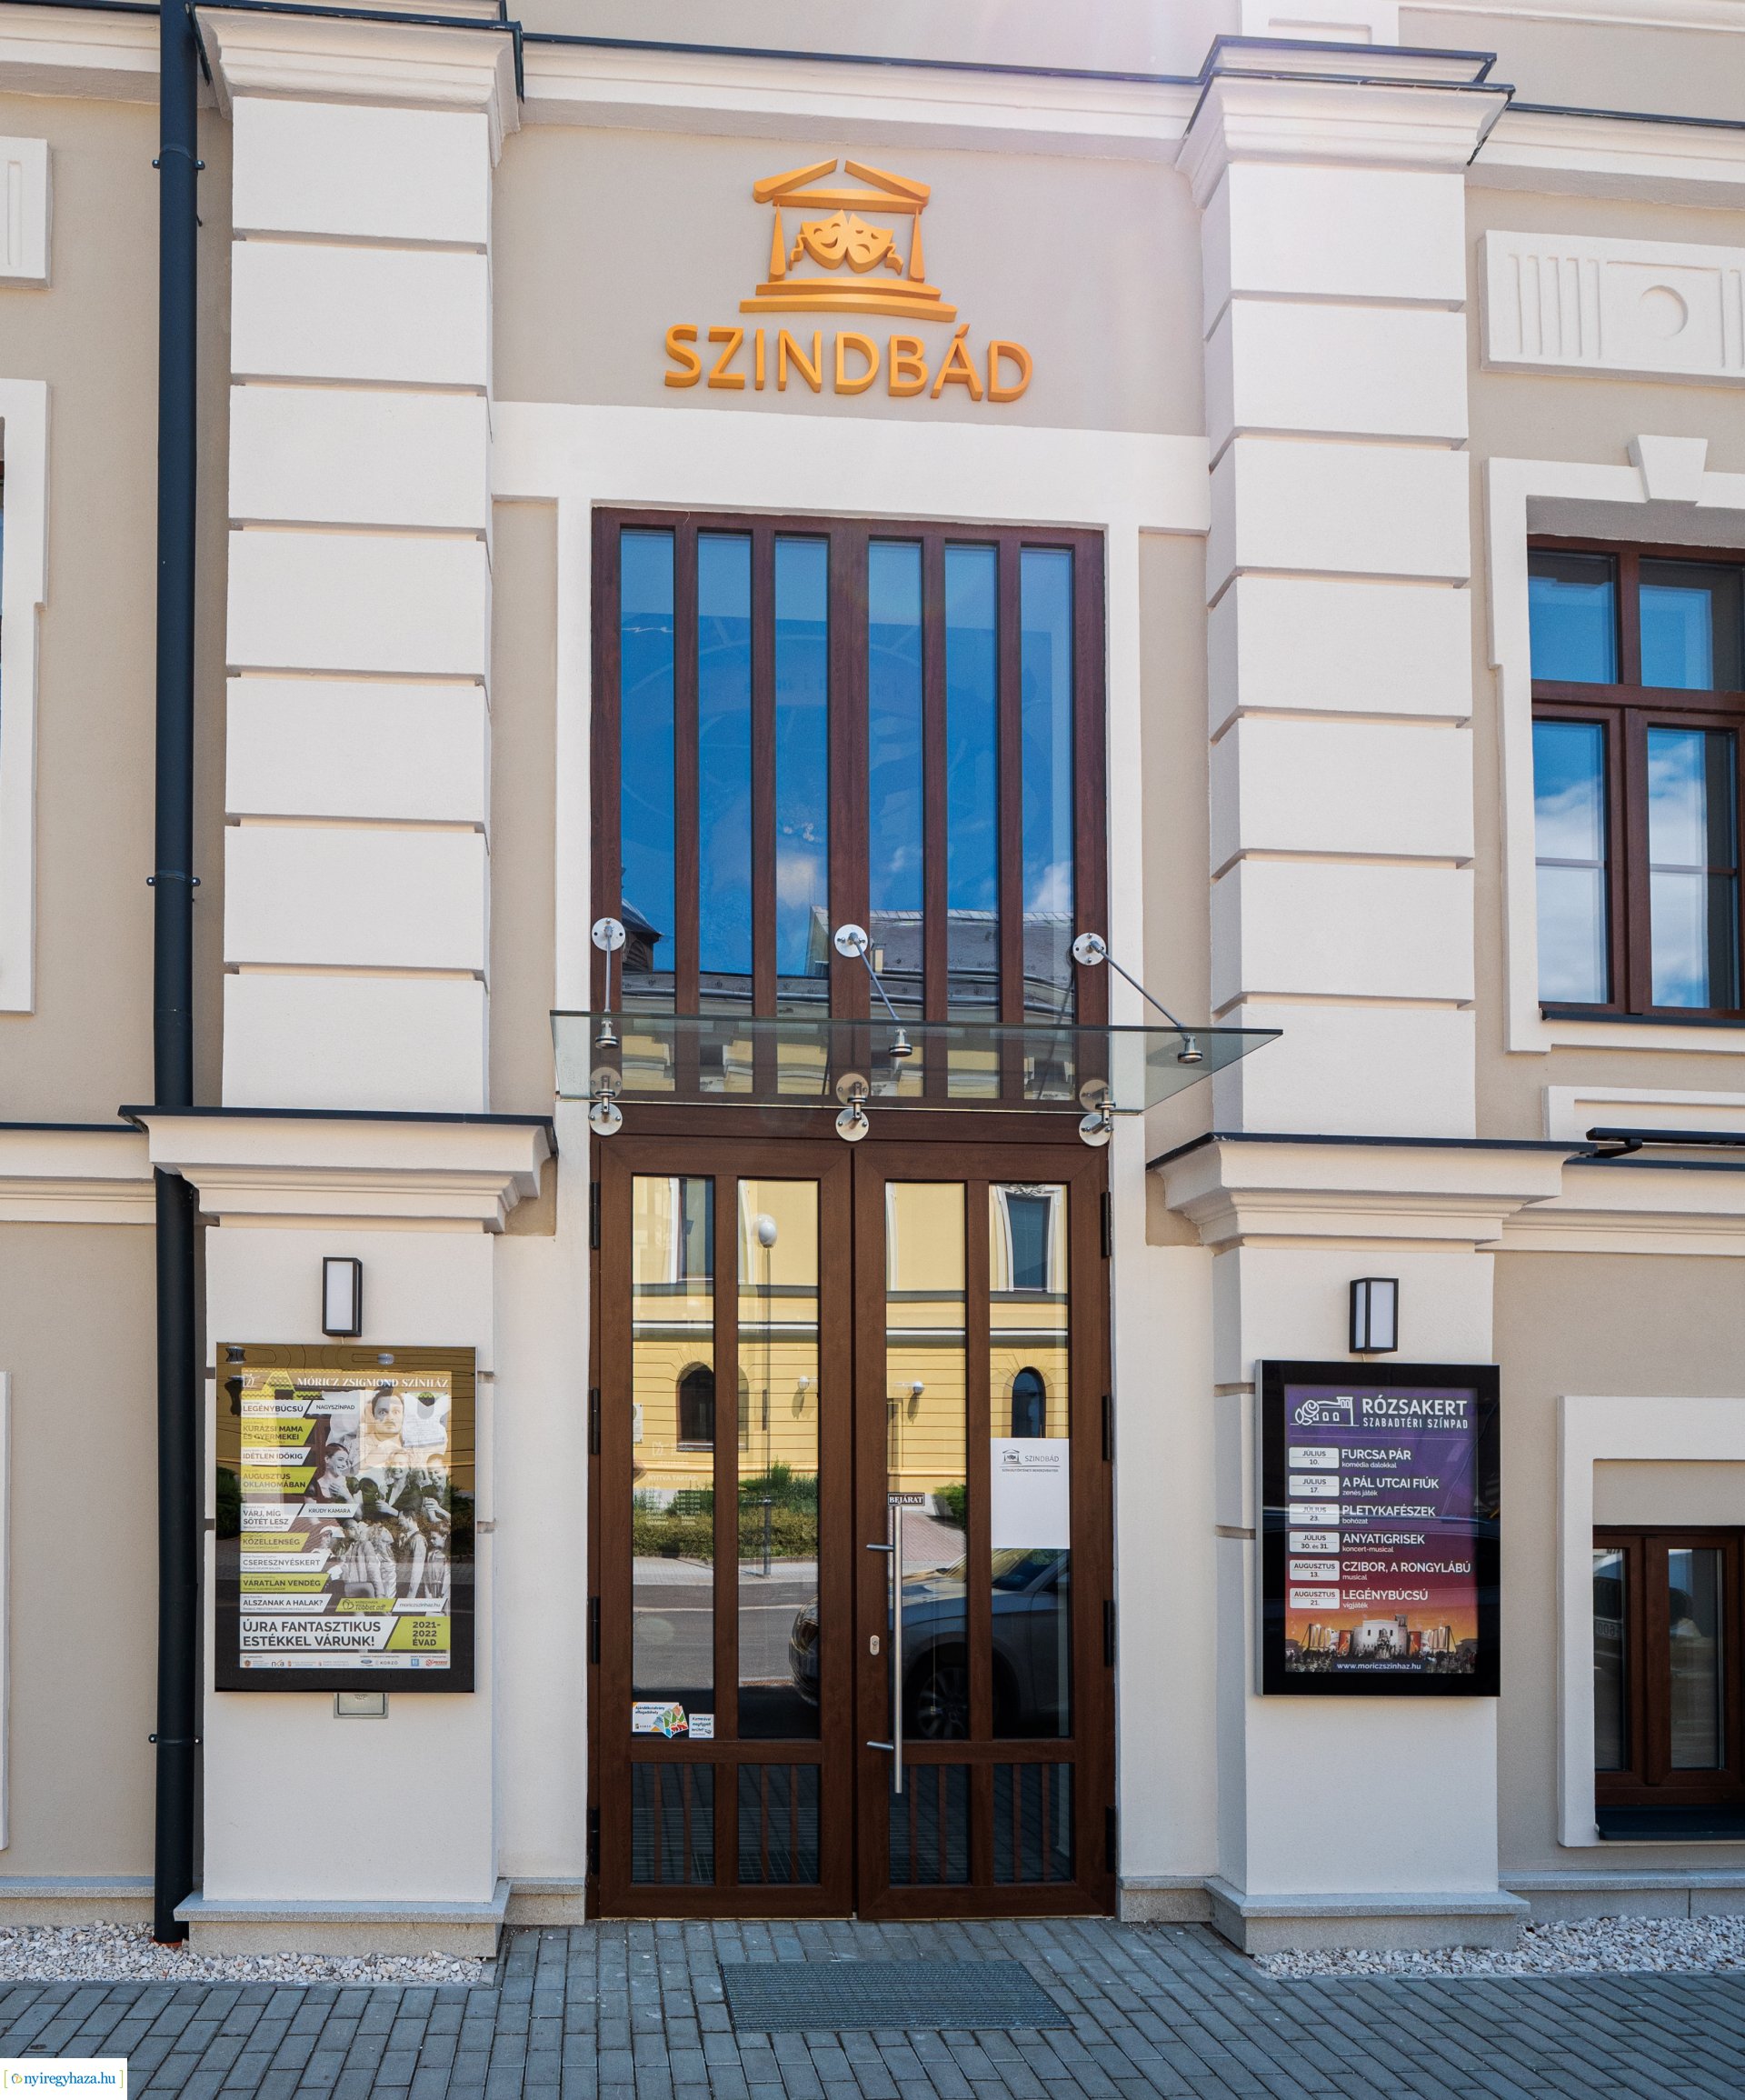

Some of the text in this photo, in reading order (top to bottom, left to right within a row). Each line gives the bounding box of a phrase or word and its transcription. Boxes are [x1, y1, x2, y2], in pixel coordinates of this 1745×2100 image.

[664, 323, 1032, 403] SZINDBÁD
[297, 1376, 449, 1387] MÓRICZ ZSIGMOND SZÍNHÁZ
[243, 1404, 304, 1412] LEGÉNYBÚCSÚ
[1362, 1395, 1468, 1415] RÓZSAKERT
[1363, 1416, 1468, 1429] SZABADTÉRI SZÍNPAD
[1341, 1448, 1411, 1460] FURCSA PÁR
[243, 1480, 305, 1488] OKLAHOMÁBAN
[1342, 1475, 1440, 1489] A PÁL UTCAI FIÚK
[889, 1495, 922, 1505] BEJÁRAT
[243, 1508, 264, 1517] VÁRJ,
[1342, 1504, 1435, 1516] PLETYKAFÉSZEK
[243, 1537, 300, 1545] KÖZELLENSÉG
[1342, 1534, 1425, 1545] ANYATIGRISEK
[243, 1557, 321, 1566] CSERESZNYÉSKERT
[1342, 1561, 1471, 1574] CZIBOR, A RONGYLÁBÚ
[1342, 1587, 1428, 1600] LEGÉNYBÚCSÚ
[243, 1618, 381, 1633] ÚJRA FANTASZTIKUS
[244, 1634, 374, 1646] ESTÉKKEL VÁRUNK!
[413, 1637, 436, 1646] ÉVAD
